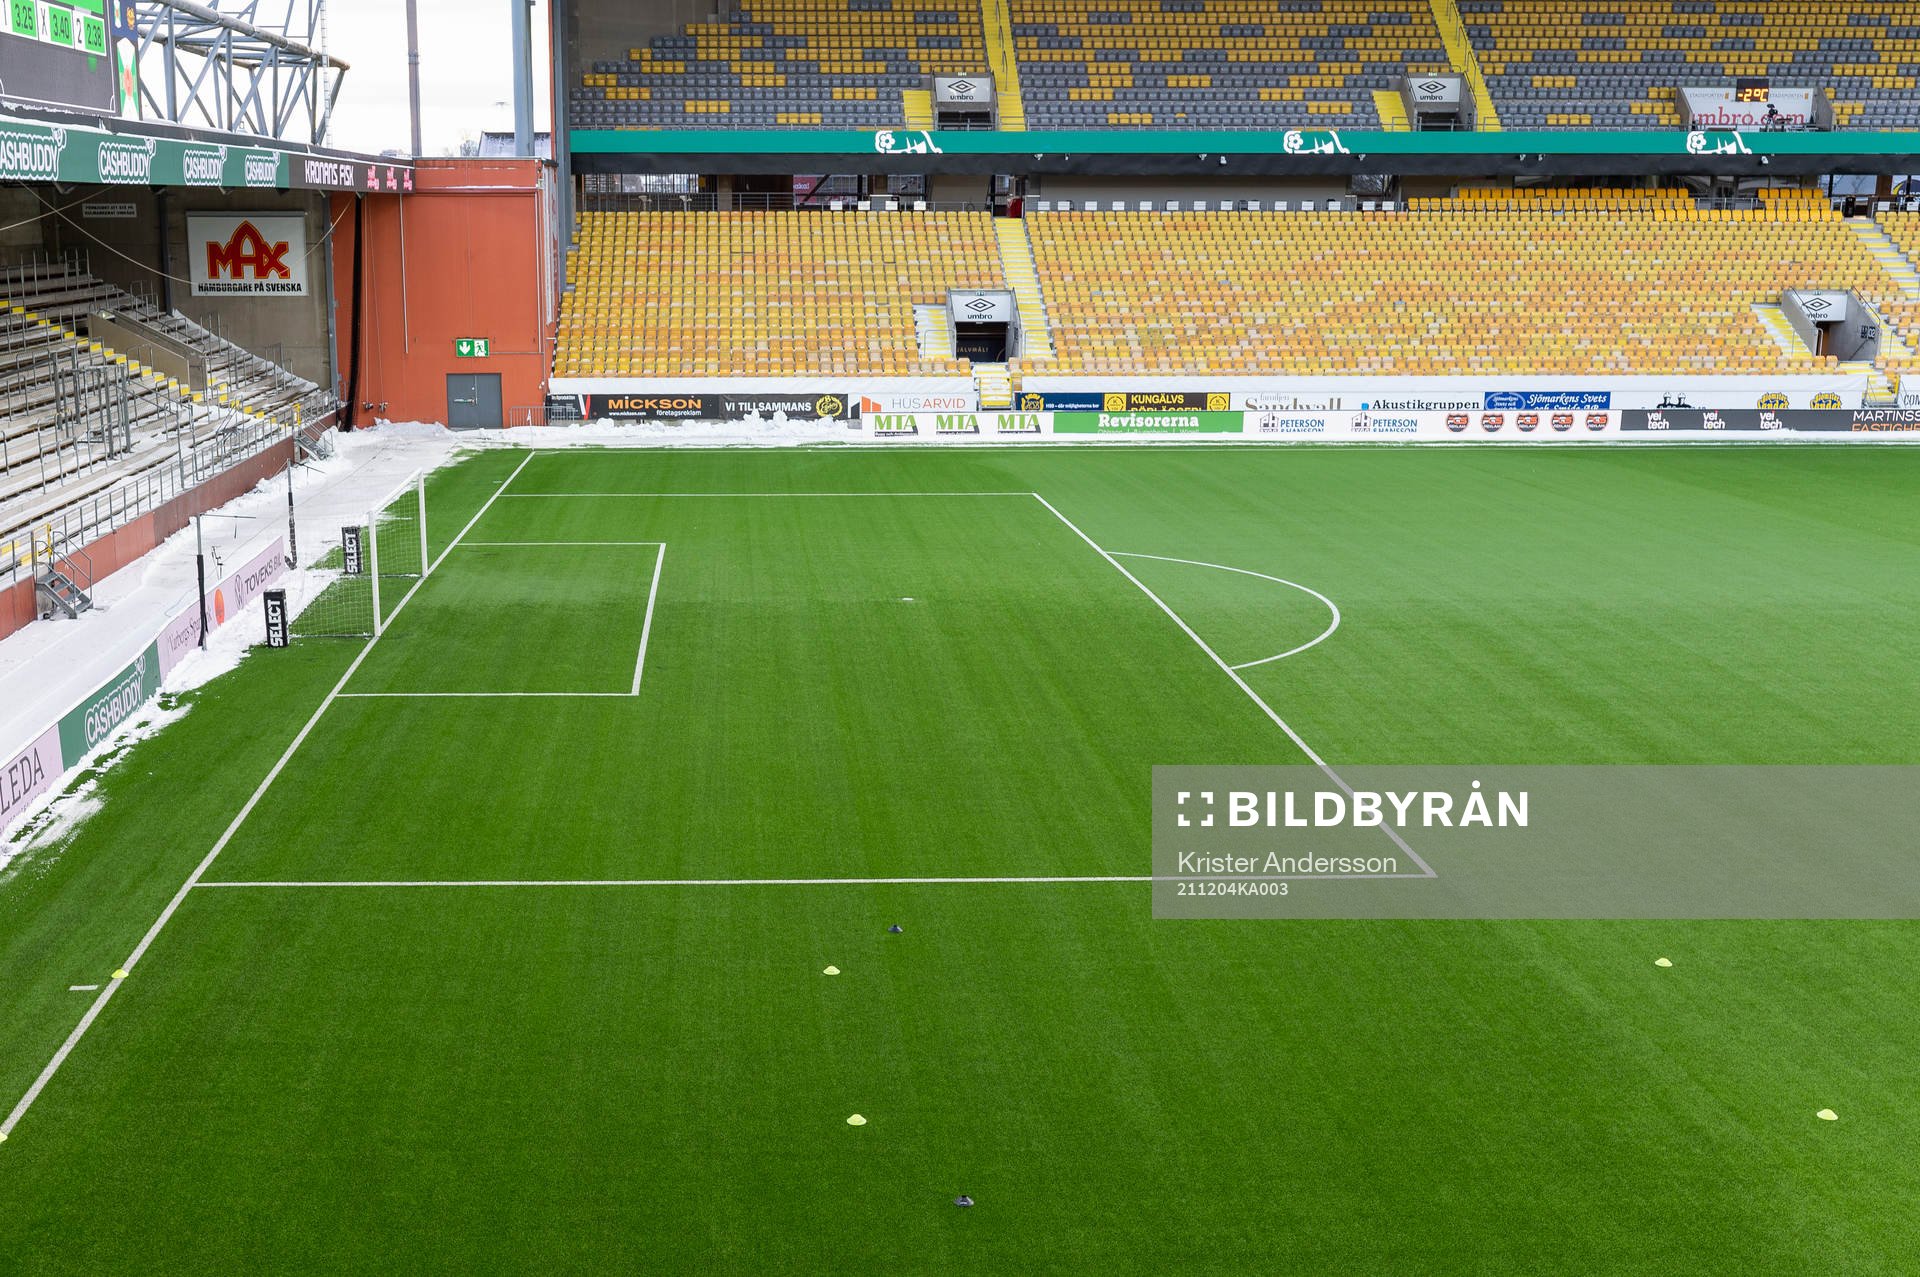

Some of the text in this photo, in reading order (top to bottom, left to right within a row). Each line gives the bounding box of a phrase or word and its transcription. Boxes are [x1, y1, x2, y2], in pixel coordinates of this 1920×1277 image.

[15, 3, 33, 30] 3.25
[41, 8, 48, 36] X
[53, 14, 69, 40] 3.40
[76, 18, 82, 44] 2
[1693, 106, 1805, 125] mbro.com
[0, 140, 57, 173] ASHBUDDY
[100, 150, 150, 177] CASHBUDDY
[184, 156, 221, 180] CASHBUDDY
[245, 161, 276, 181] CASHBUDDY
[305, 160, 338, 185] KRONANS
[339, 164, 355, 187] FISK
[206, 219, 291, 279] MAX
[198, 280, 302, 292] HAMBURGARE PÅ SVENSKA
[725, 402, 735, 412] VI
[738, 402, 812, 412] TILLSAMMANS
[892, 398, 966, 409] HUS ARVID
[1131, 393, 1184, 404] KUNGÄLVS
[1373, 400, 1480, 410] Akustikgruppen
[1527, 393, 1607, 406] Sjömarkens Svets
[875, 415, 918, 433] MTA
[936, 414, 979, 432] MTA
[998, 414, 1041, 432] MTA
[1098, 413, 1199, 428] Revisorerna
[1280, 419, 1325, 428] PETERSON
[1373, 419, 1418, 428] PETERSON
[1648, 419, 1669, 429] tech
[1703, 419, 1725, 429] tech
[1760, 419, 1782, 429] tech
[345, 533, 358, 574] SELECT
[245, 558, 274, 595] TOVEKS
[268, 600, 284, 647] SELECT
[87, 677, 142, 743] CASHBUDDY
